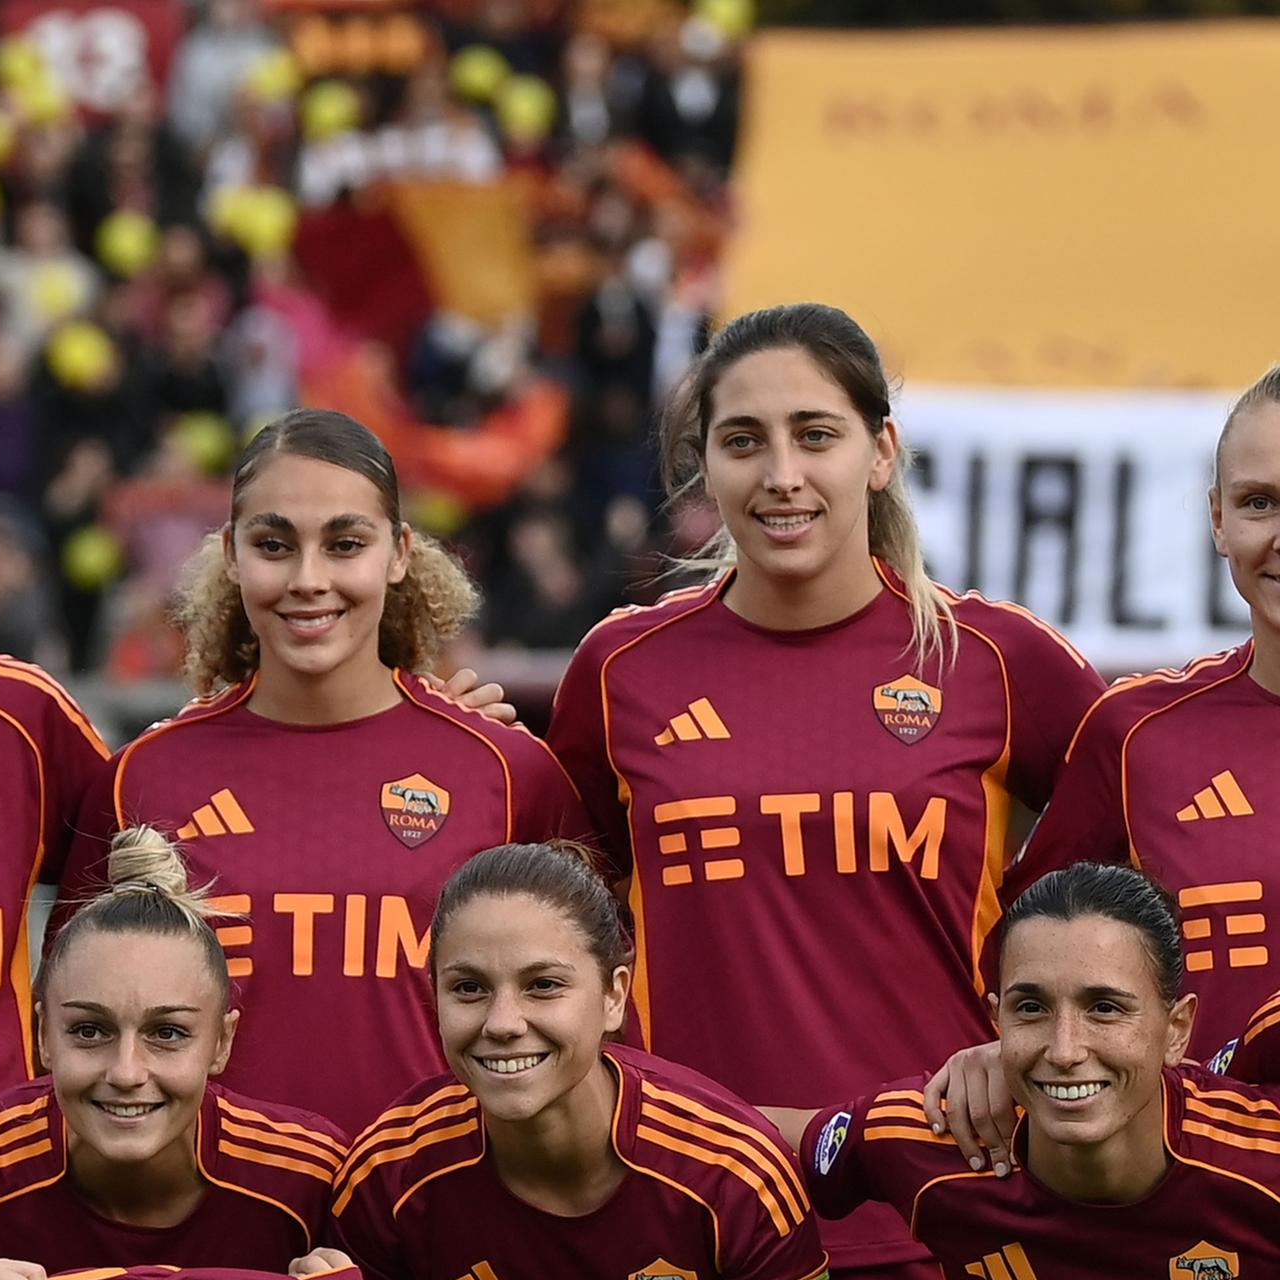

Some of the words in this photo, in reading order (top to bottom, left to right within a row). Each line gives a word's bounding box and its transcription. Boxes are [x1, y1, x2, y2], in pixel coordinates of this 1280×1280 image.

[883, 712, 932, 729] ROMA
[389, 812, 437, 832] ROMA
[760, 791, 947, 880] TIM
